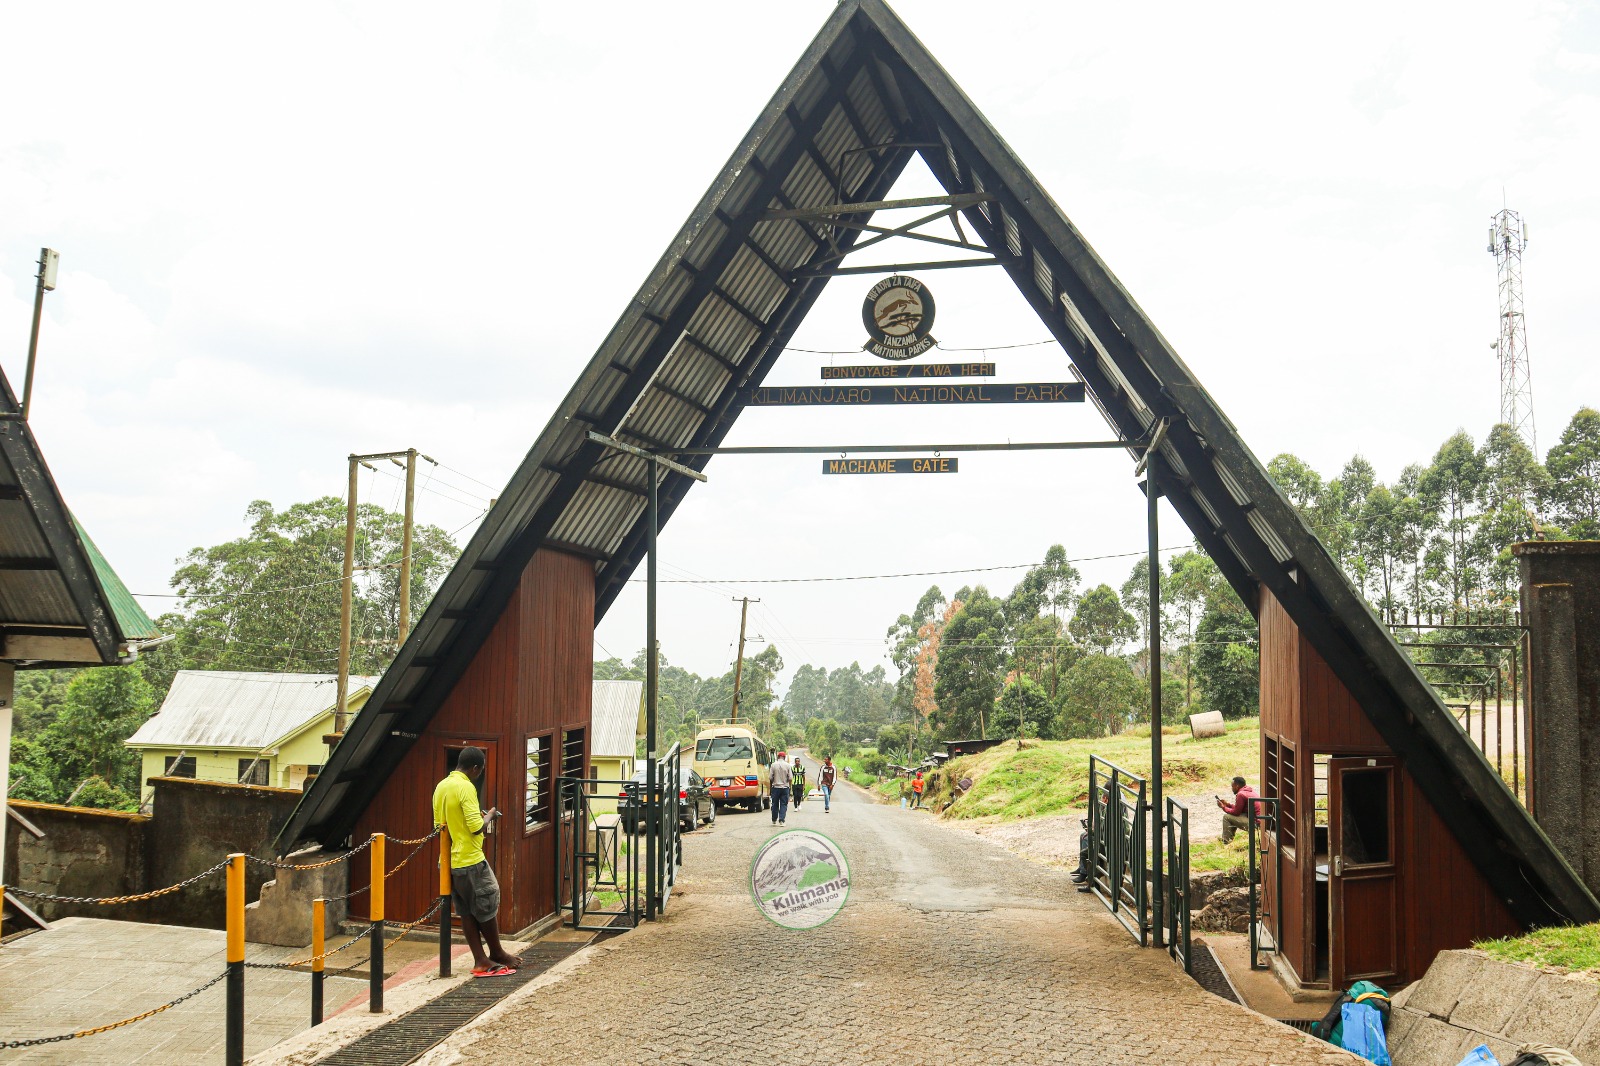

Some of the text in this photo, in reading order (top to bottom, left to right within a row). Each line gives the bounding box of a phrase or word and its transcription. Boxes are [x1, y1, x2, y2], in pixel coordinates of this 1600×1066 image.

[866, 276, 922, 301] HIFADHI ZA TAIFA
[872, 338, 931, 359] NATIONAL PARKS
[883, 333, 918, 347] TANZANIA
[823, 365, 899, 379] BONVOYAGE
[923, 364, 952, 377] KWA
[961, 363, 994, 376] HERI
[751, 385, 1069, 404] KILIMANJARO NATIONAL PARK
[829, 458, 950, 474] MACHAME GATE
